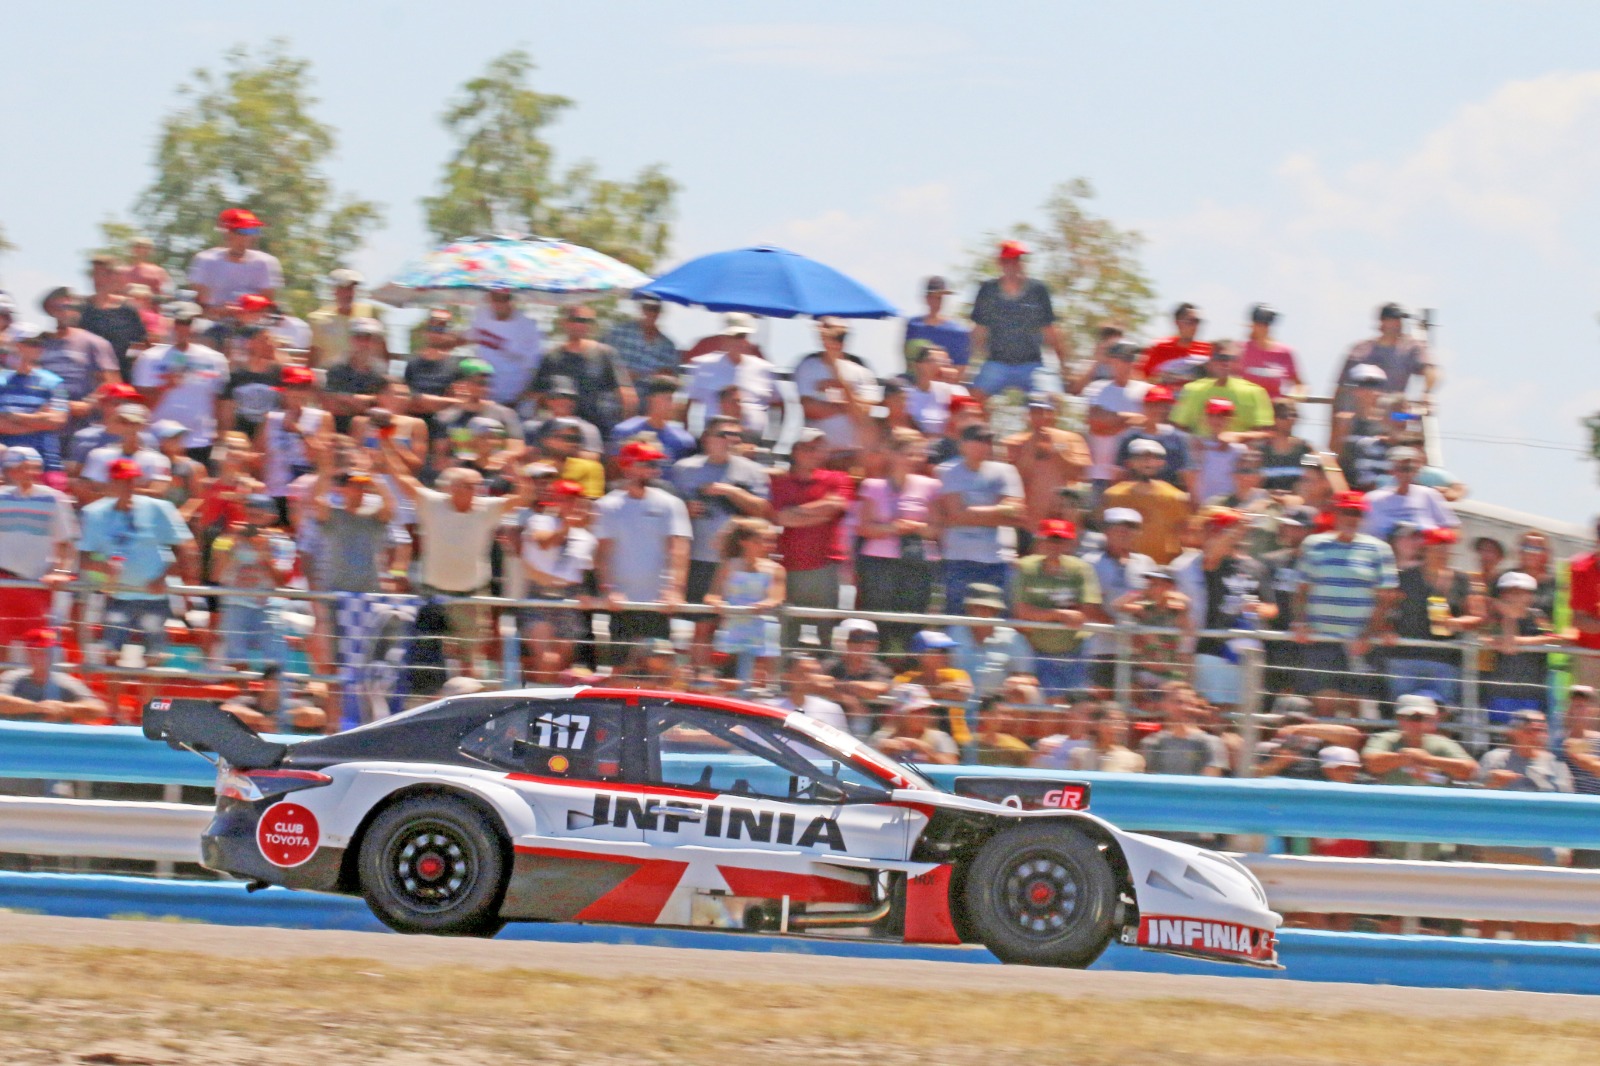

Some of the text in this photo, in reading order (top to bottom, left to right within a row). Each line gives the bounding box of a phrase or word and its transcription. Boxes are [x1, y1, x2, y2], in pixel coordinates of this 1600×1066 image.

[150, 701, 171, 710] GR
[536, 712, 590, 750] 117
[1043, 789, 1082, 809] GR
[274, 822, 304, 834] CLUB
[592, 793, 848, 853] INFINIA
[265, 833, 310, 847] TOYOTA
[1148, 919, 1252, 955] INFINIA
